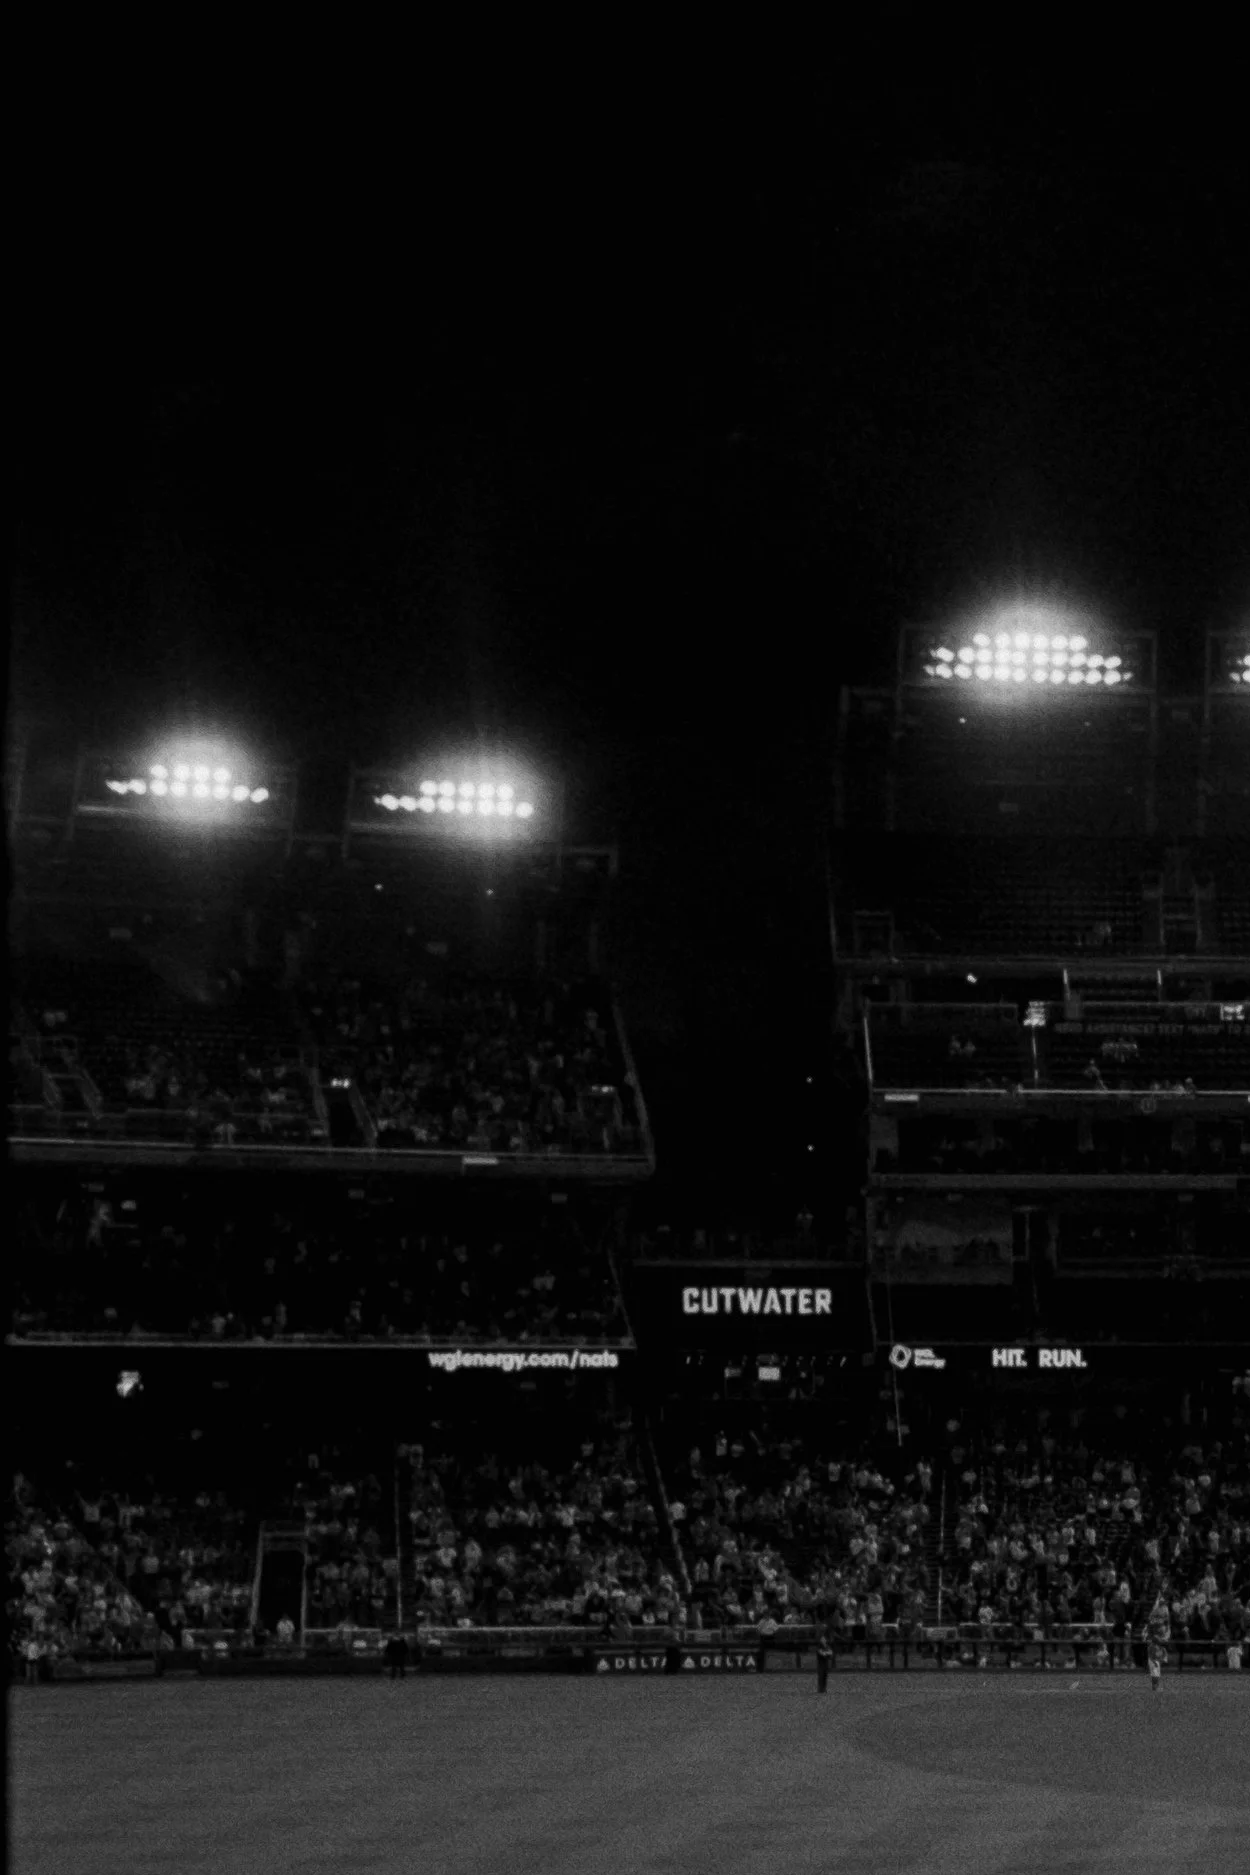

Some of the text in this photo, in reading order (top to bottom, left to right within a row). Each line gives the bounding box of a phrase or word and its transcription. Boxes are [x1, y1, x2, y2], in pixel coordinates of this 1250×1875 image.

[682, 1286, 833, 1315] CUTWATER
[992, 1348, 1088, 1368] HIT. RUN.
[700, 1656, 757, 1668] DELTA
